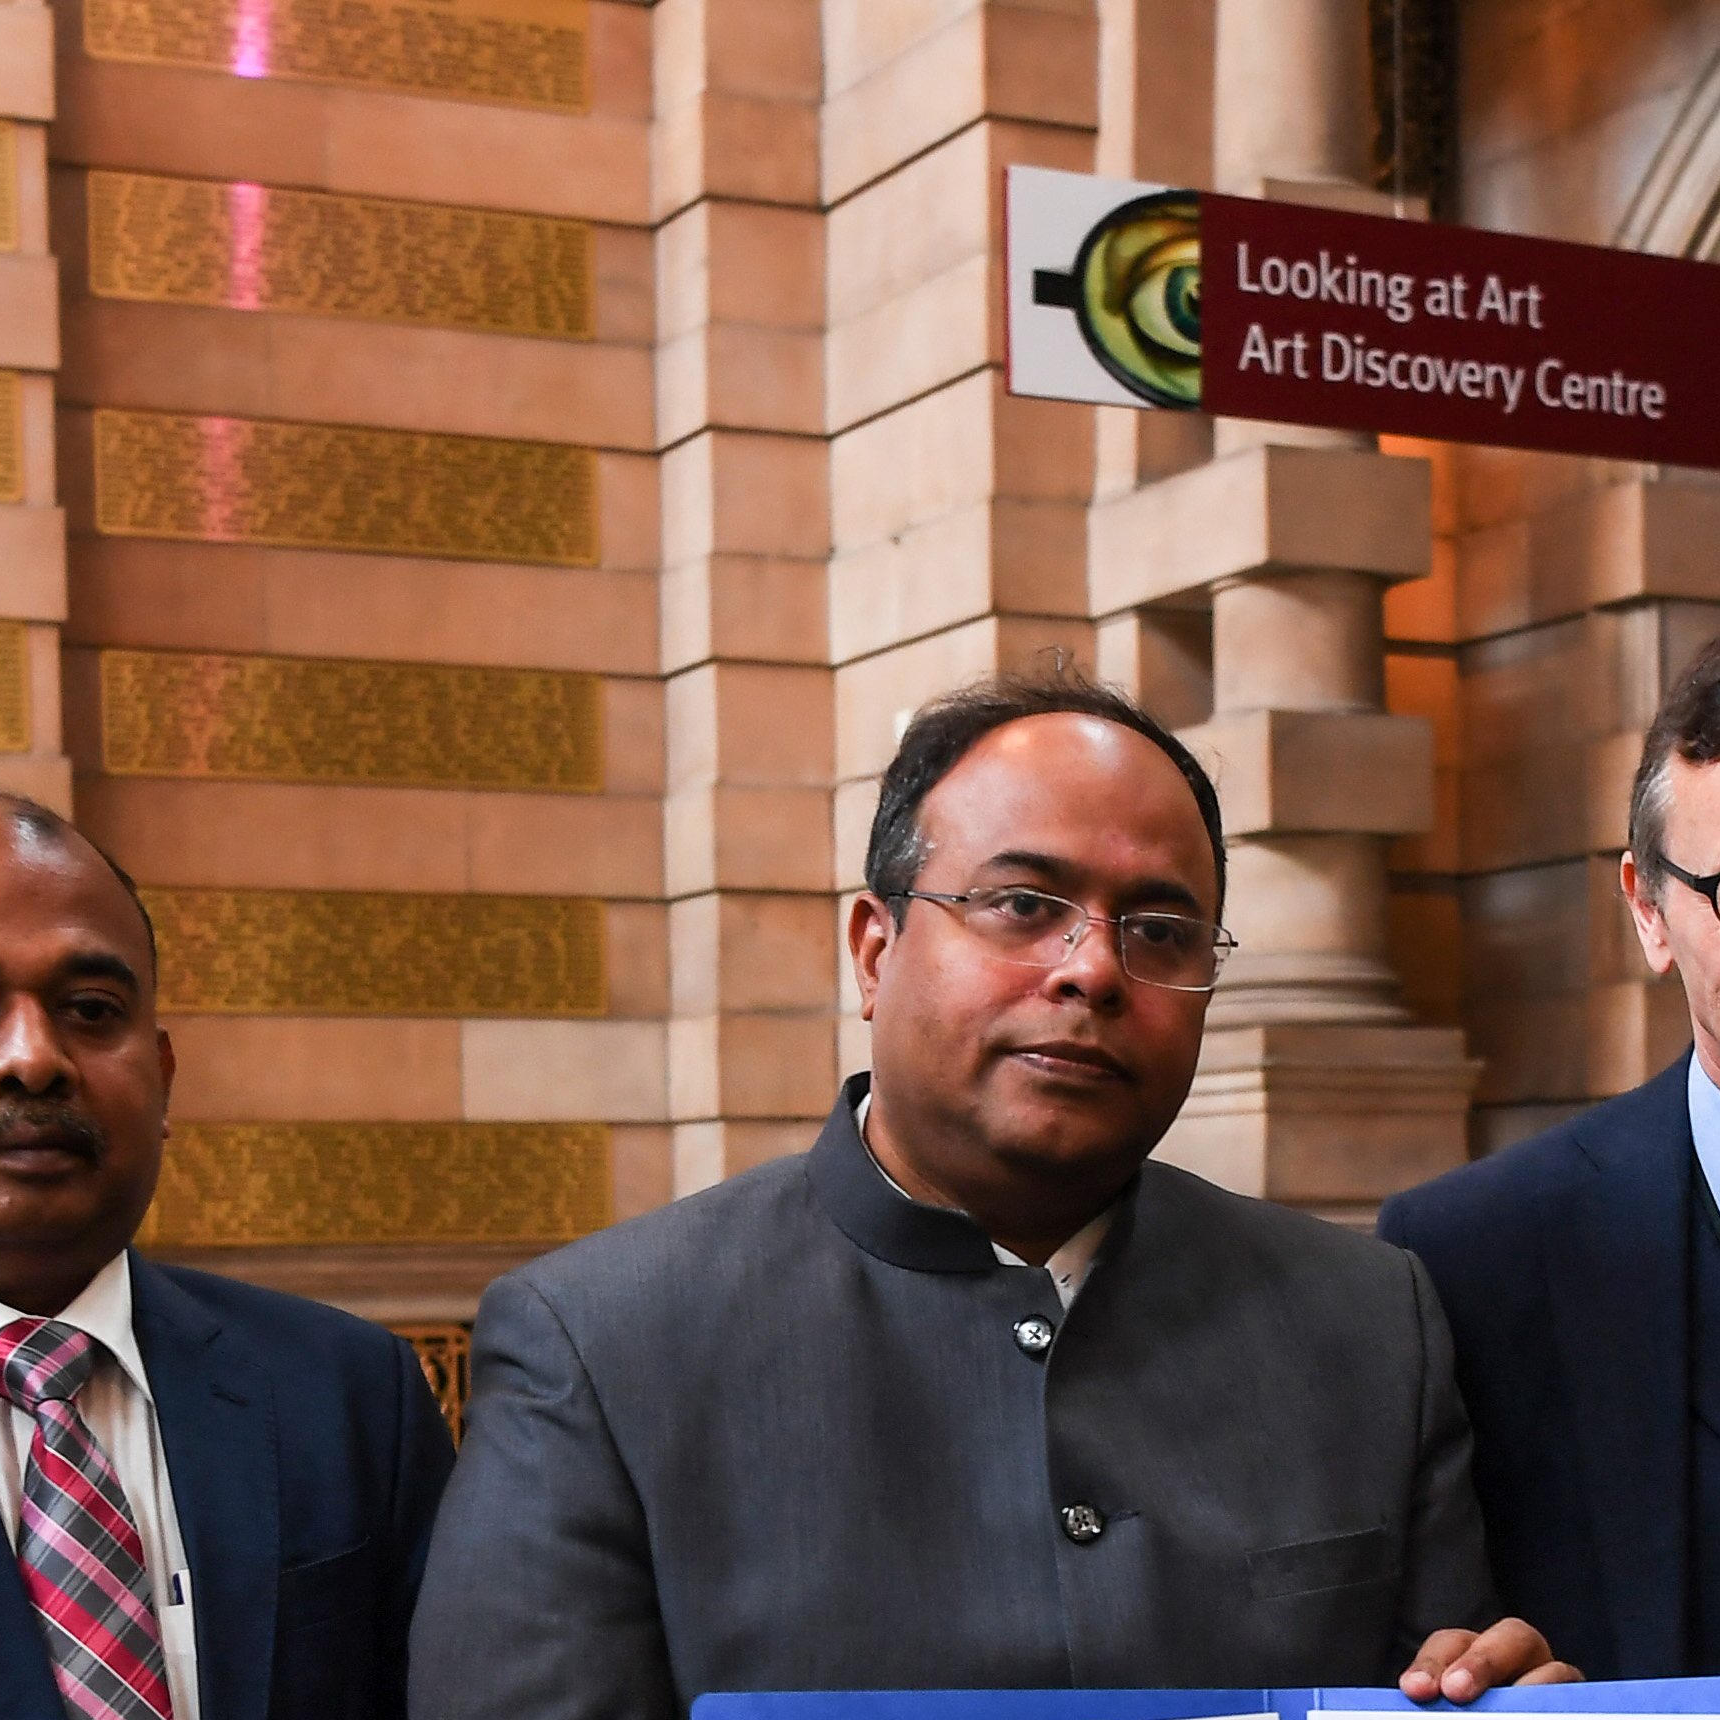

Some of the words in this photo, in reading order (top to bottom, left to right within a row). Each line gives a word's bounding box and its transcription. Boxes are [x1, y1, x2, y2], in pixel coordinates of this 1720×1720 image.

[1237, 241, 1415, 323] Looking
[1425, 275, 1468, 319] at
[1477, 275, 1543, 329] Art
[1238, 323, 1308, 379] Art
[1321, 331, 1525, 413] Discovery
[1535, 357, 1666, 419] Centre
